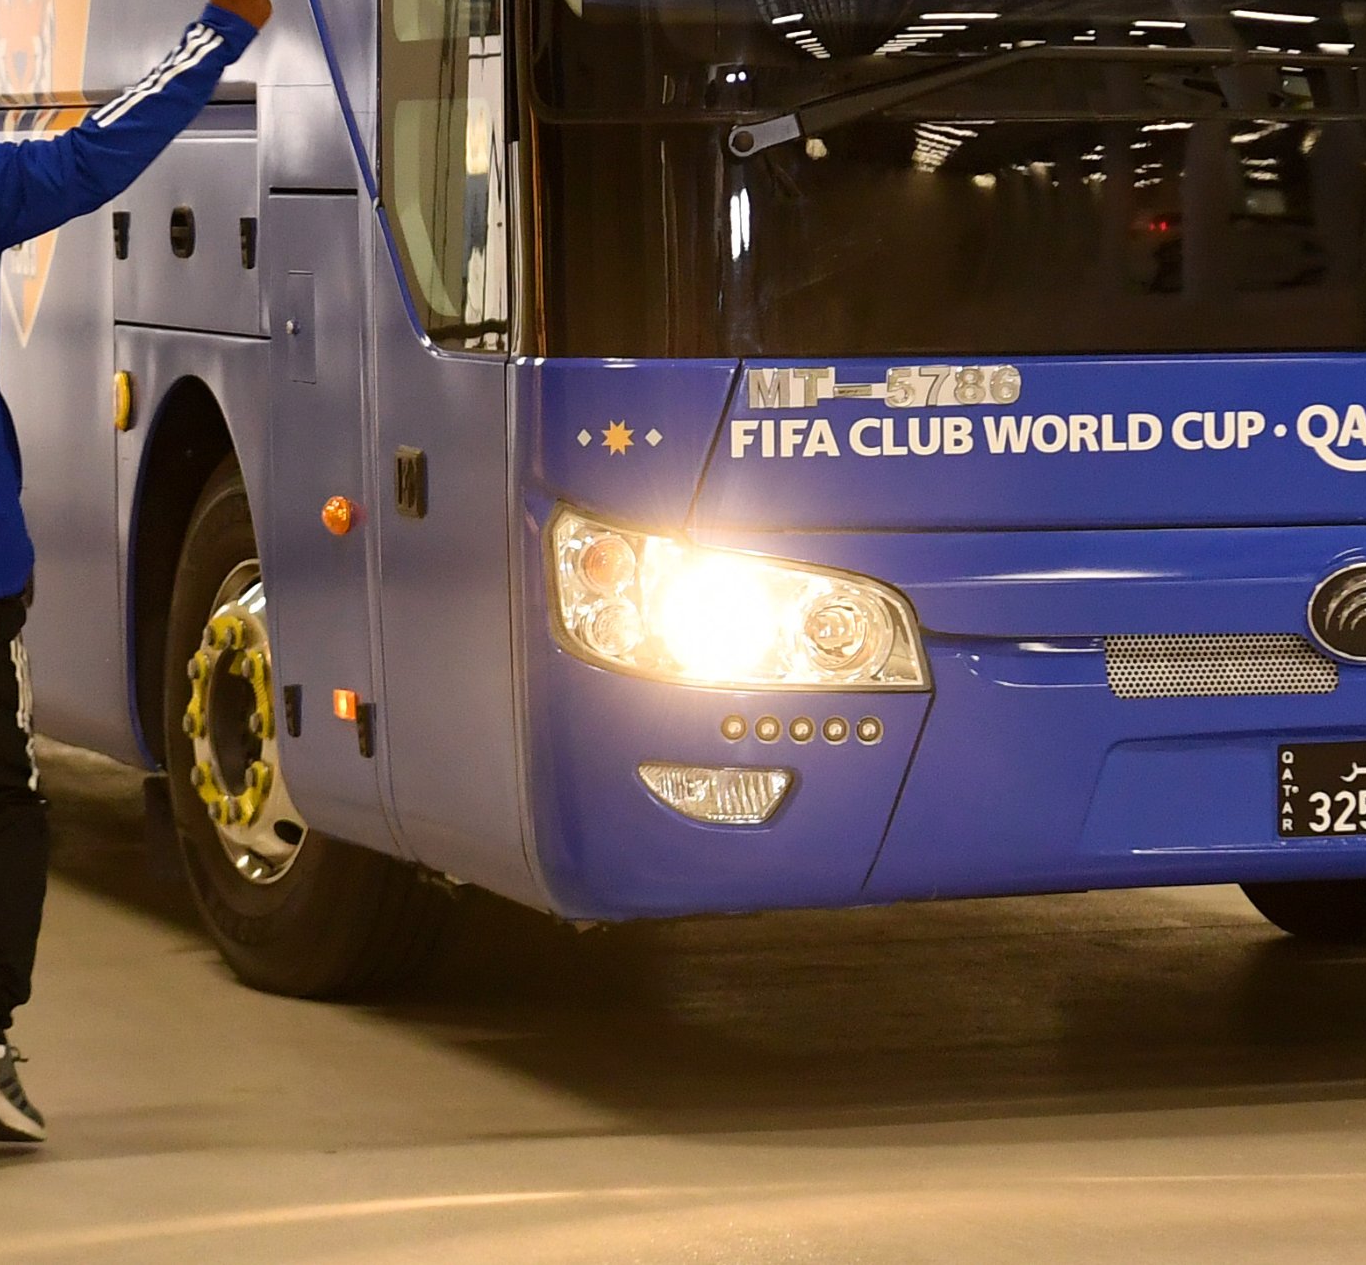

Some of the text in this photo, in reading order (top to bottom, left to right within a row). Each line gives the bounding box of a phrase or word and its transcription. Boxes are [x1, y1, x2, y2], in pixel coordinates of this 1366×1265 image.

[730, 418, 840, 458] FIFA
[848, 416, 974, 456] CLUB
[982, 411, 1163, 453] WORLD
[1171, 410, 1264, 450] CUP
[1281, 751, 1294, 831] QATAR
